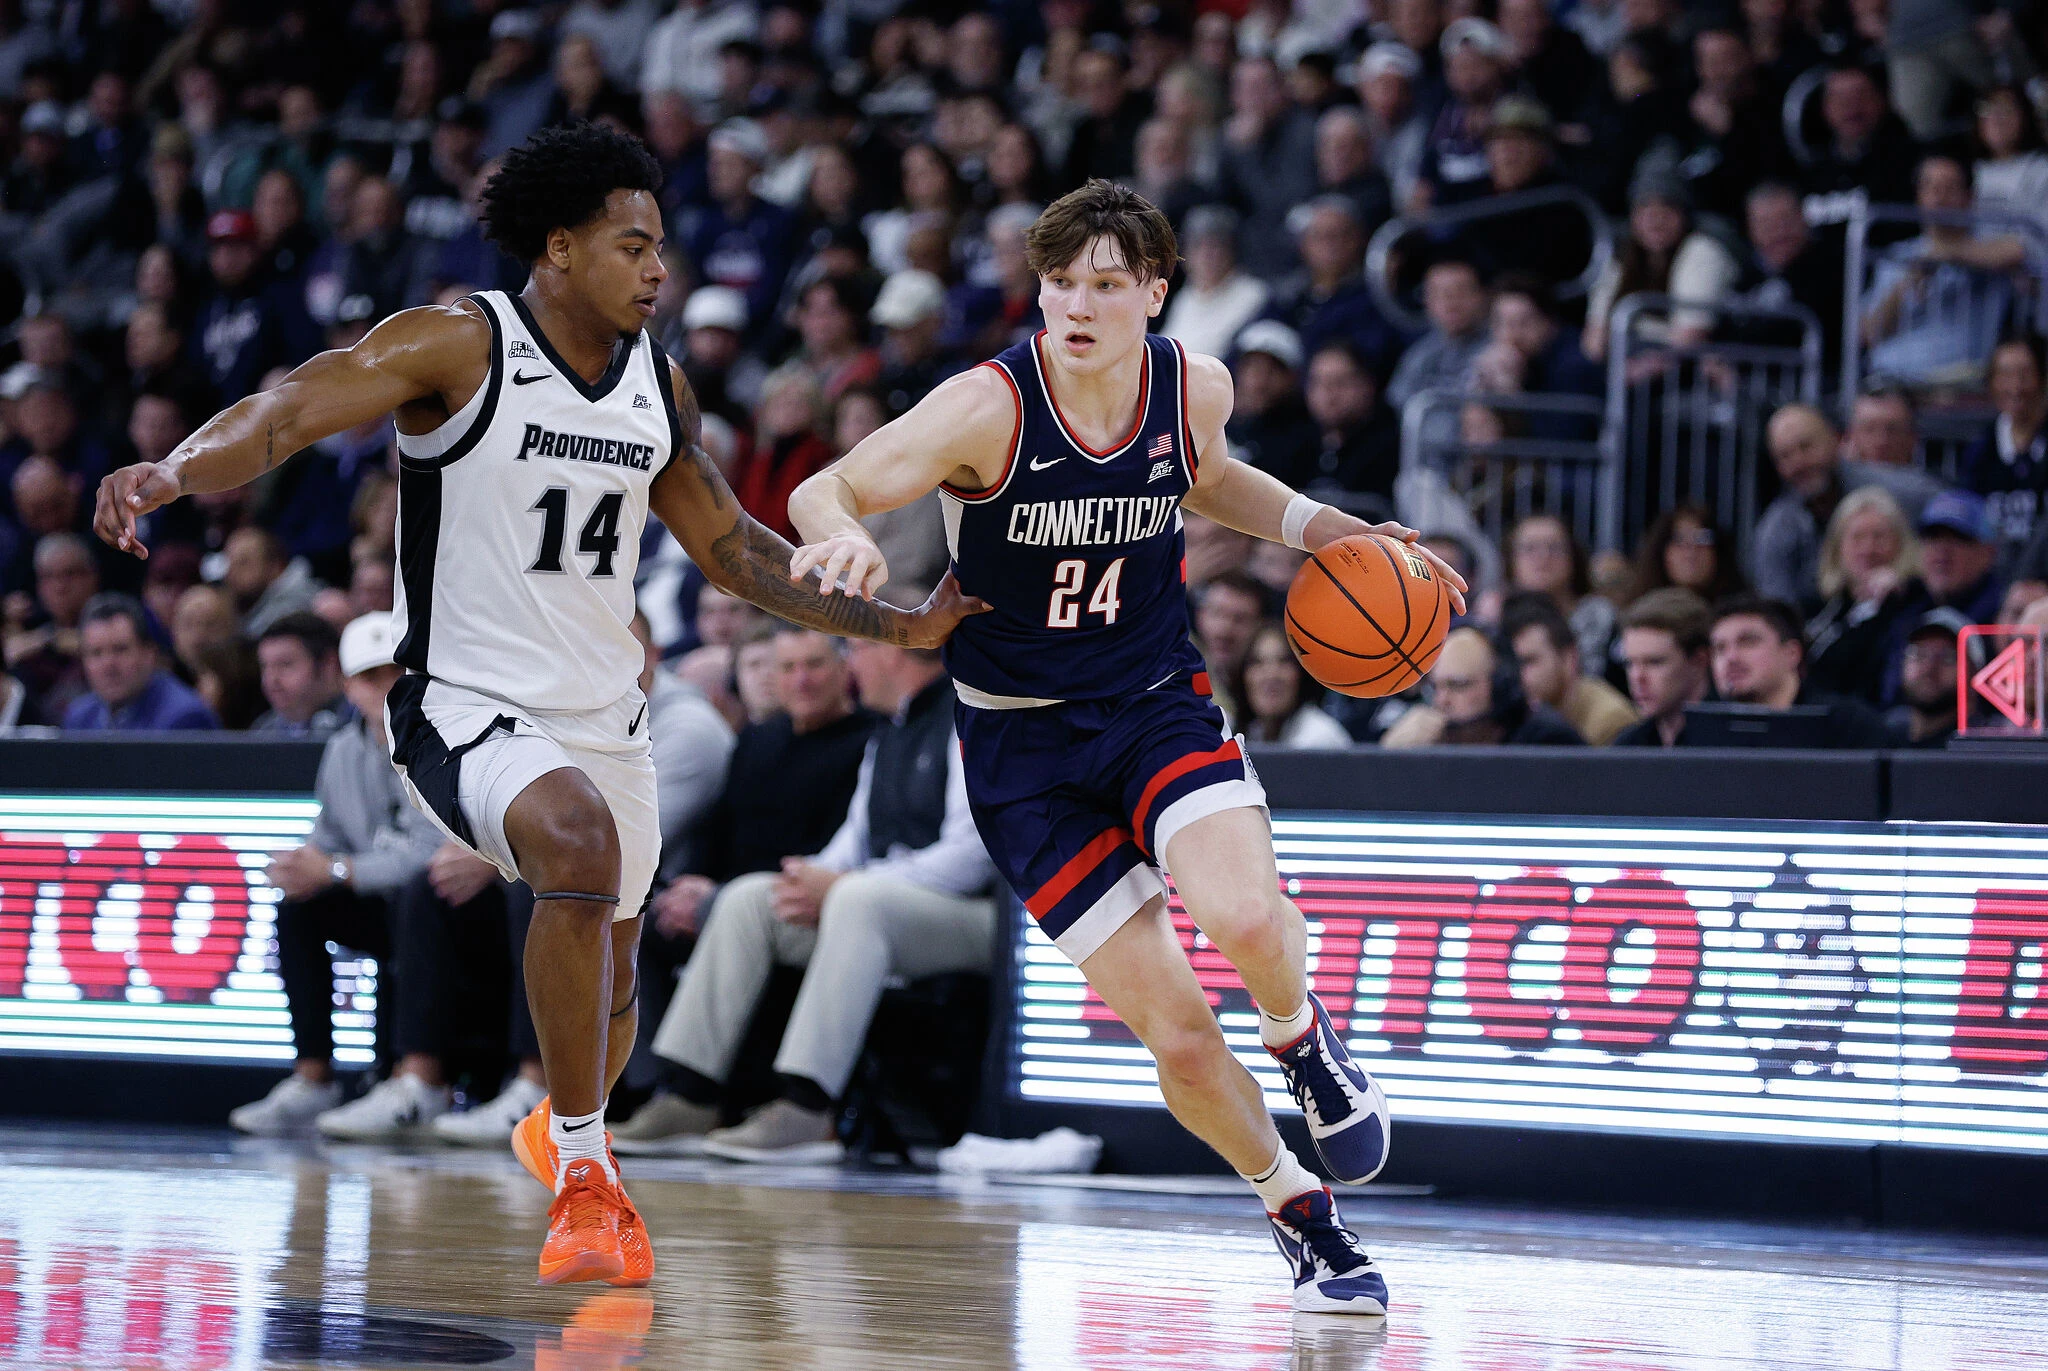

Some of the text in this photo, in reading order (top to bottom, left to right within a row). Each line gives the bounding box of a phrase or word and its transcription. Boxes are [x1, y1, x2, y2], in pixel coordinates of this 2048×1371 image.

[511, 341, 523, 350] BE
[632, 400, 652, 410] EAST
[634, 393, 648, 403] BIG
[1149, 465, 1175, 479] EAST
[1151, 459, 1171, 471] BIG
[1007, 495, 1178, 546] CONNECTICUT
[523, 485, 627, 579] 14
[1046, 557, 1128, 628] 24
[0, 833, 249, 998] TCO
